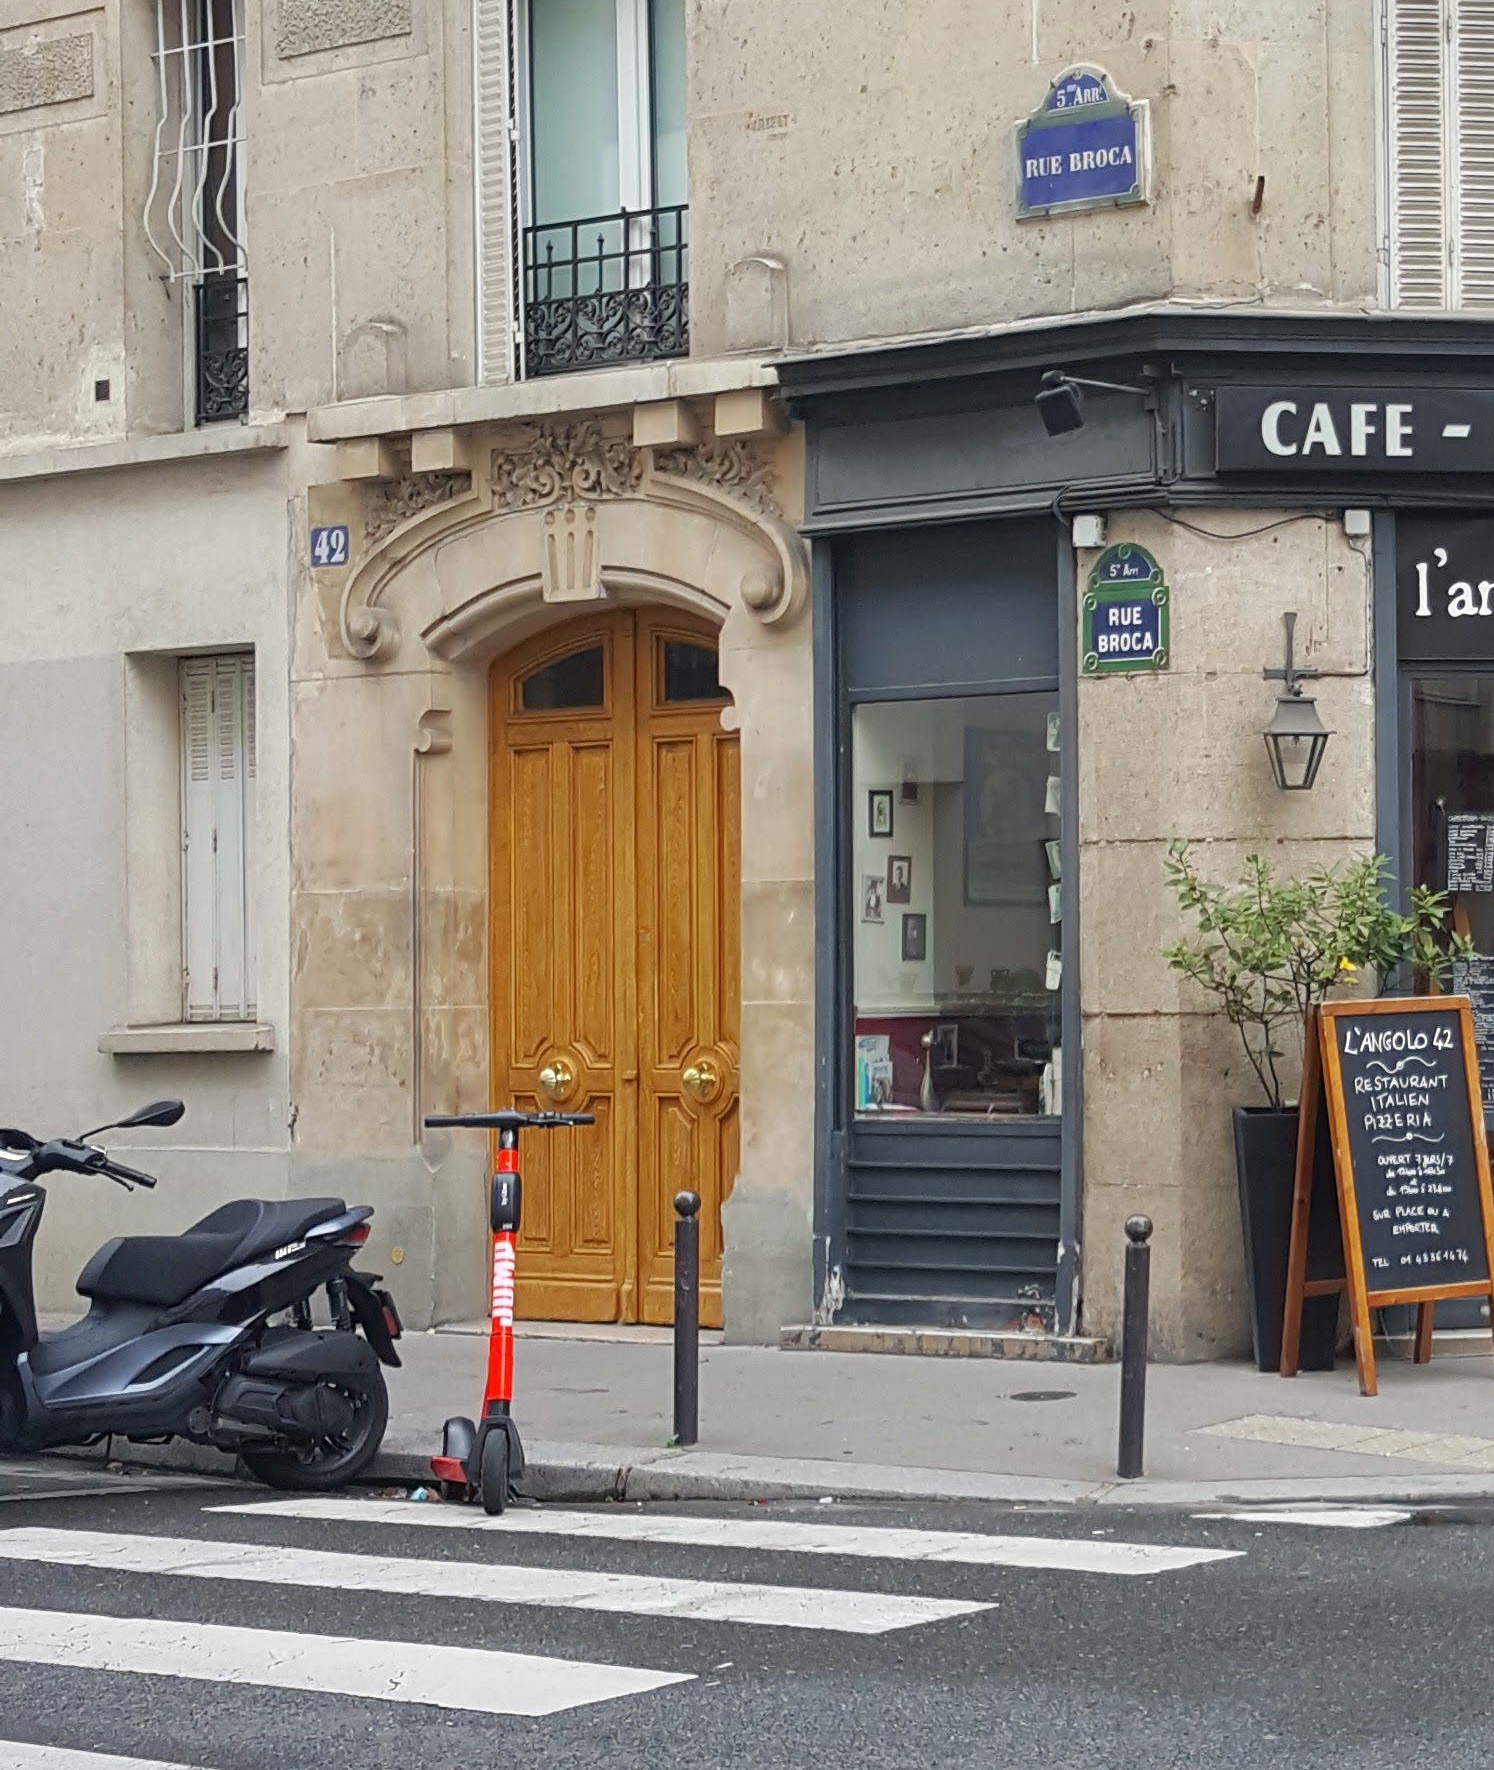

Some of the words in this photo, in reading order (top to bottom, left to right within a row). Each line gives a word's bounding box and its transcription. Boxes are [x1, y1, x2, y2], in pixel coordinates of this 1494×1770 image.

[1026, 155, 1062, 179] RUE
[1069, 145, 1132, 173] BROCA
[1261, 400, 1413, 457] CAFE
[314, 529, 345, 564] 42
[1108, 607, 1143, 627] RUE
[1098, 632, 1153, 653] BROCA
[1432, 1028, 1454, 1051] 42
[1354, 1074, 1448, 1095] RESTAURANT
[1370, 1093, 1429, 1112] ITALIEN
[1364, 1112, 1432, 1131] PIZZERIA
[1377, 1154, 1411, 1166] OUVERT
[1372, 1209, 1391, 1221] SUR
[1395, 1205, 1425, 1218] PLACE
[1427, 1207, 1439, 1216] OU
[1392, 1222, 1440, 1235] EMPORTER
[1372, 1258, 1390, 1268] TEL
